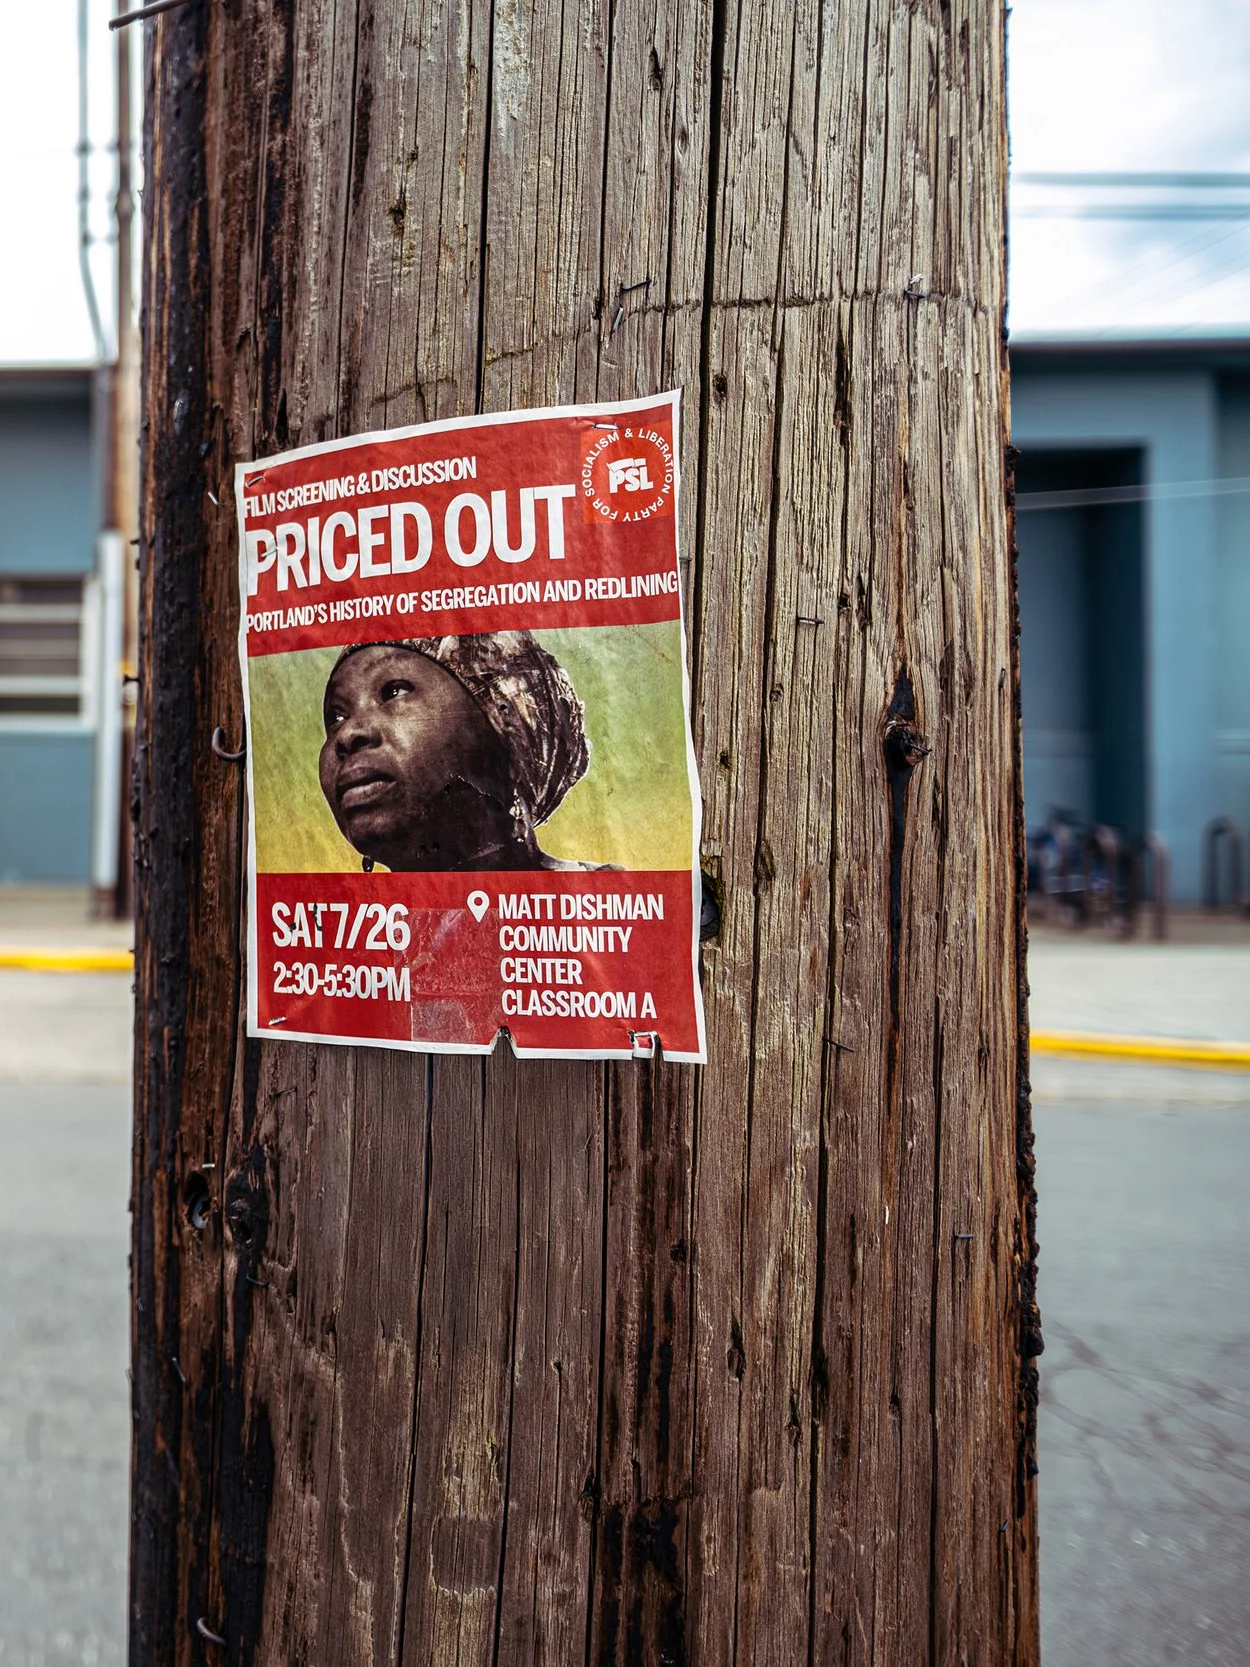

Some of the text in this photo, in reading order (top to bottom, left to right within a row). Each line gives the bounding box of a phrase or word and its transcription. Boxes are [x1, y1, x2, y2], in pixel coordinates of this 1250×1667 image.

[245, 456, 477, 518] FILM SCREENING & DISCUSSION
[582, 428, 674, 522] PARTY FOR SOCIALISM & LIBERATION
[609, 467, 654, 494] PSL
[246, 484, 576, 596] PRICED OUT
[330, 595, 394, 622] HISTORY
[396, 592, 419, 614] OF
[420, 581, 540, 612] SEGREGATION
[543, 579, 582, 603] AND
[584, 570, 678, 600] REDLINING
[271, 902, 411, 951] SAT 7/26
[498, 894, 664, 920] MATT DISHMAN
[499, 926, 633, 953] COMMUNITY
[273, 961, 411, 1002] 2:30-5:30PM
[500, 957, 583, 985] CENTER
[501, 989, 658, 1019] CLASSROOM A
